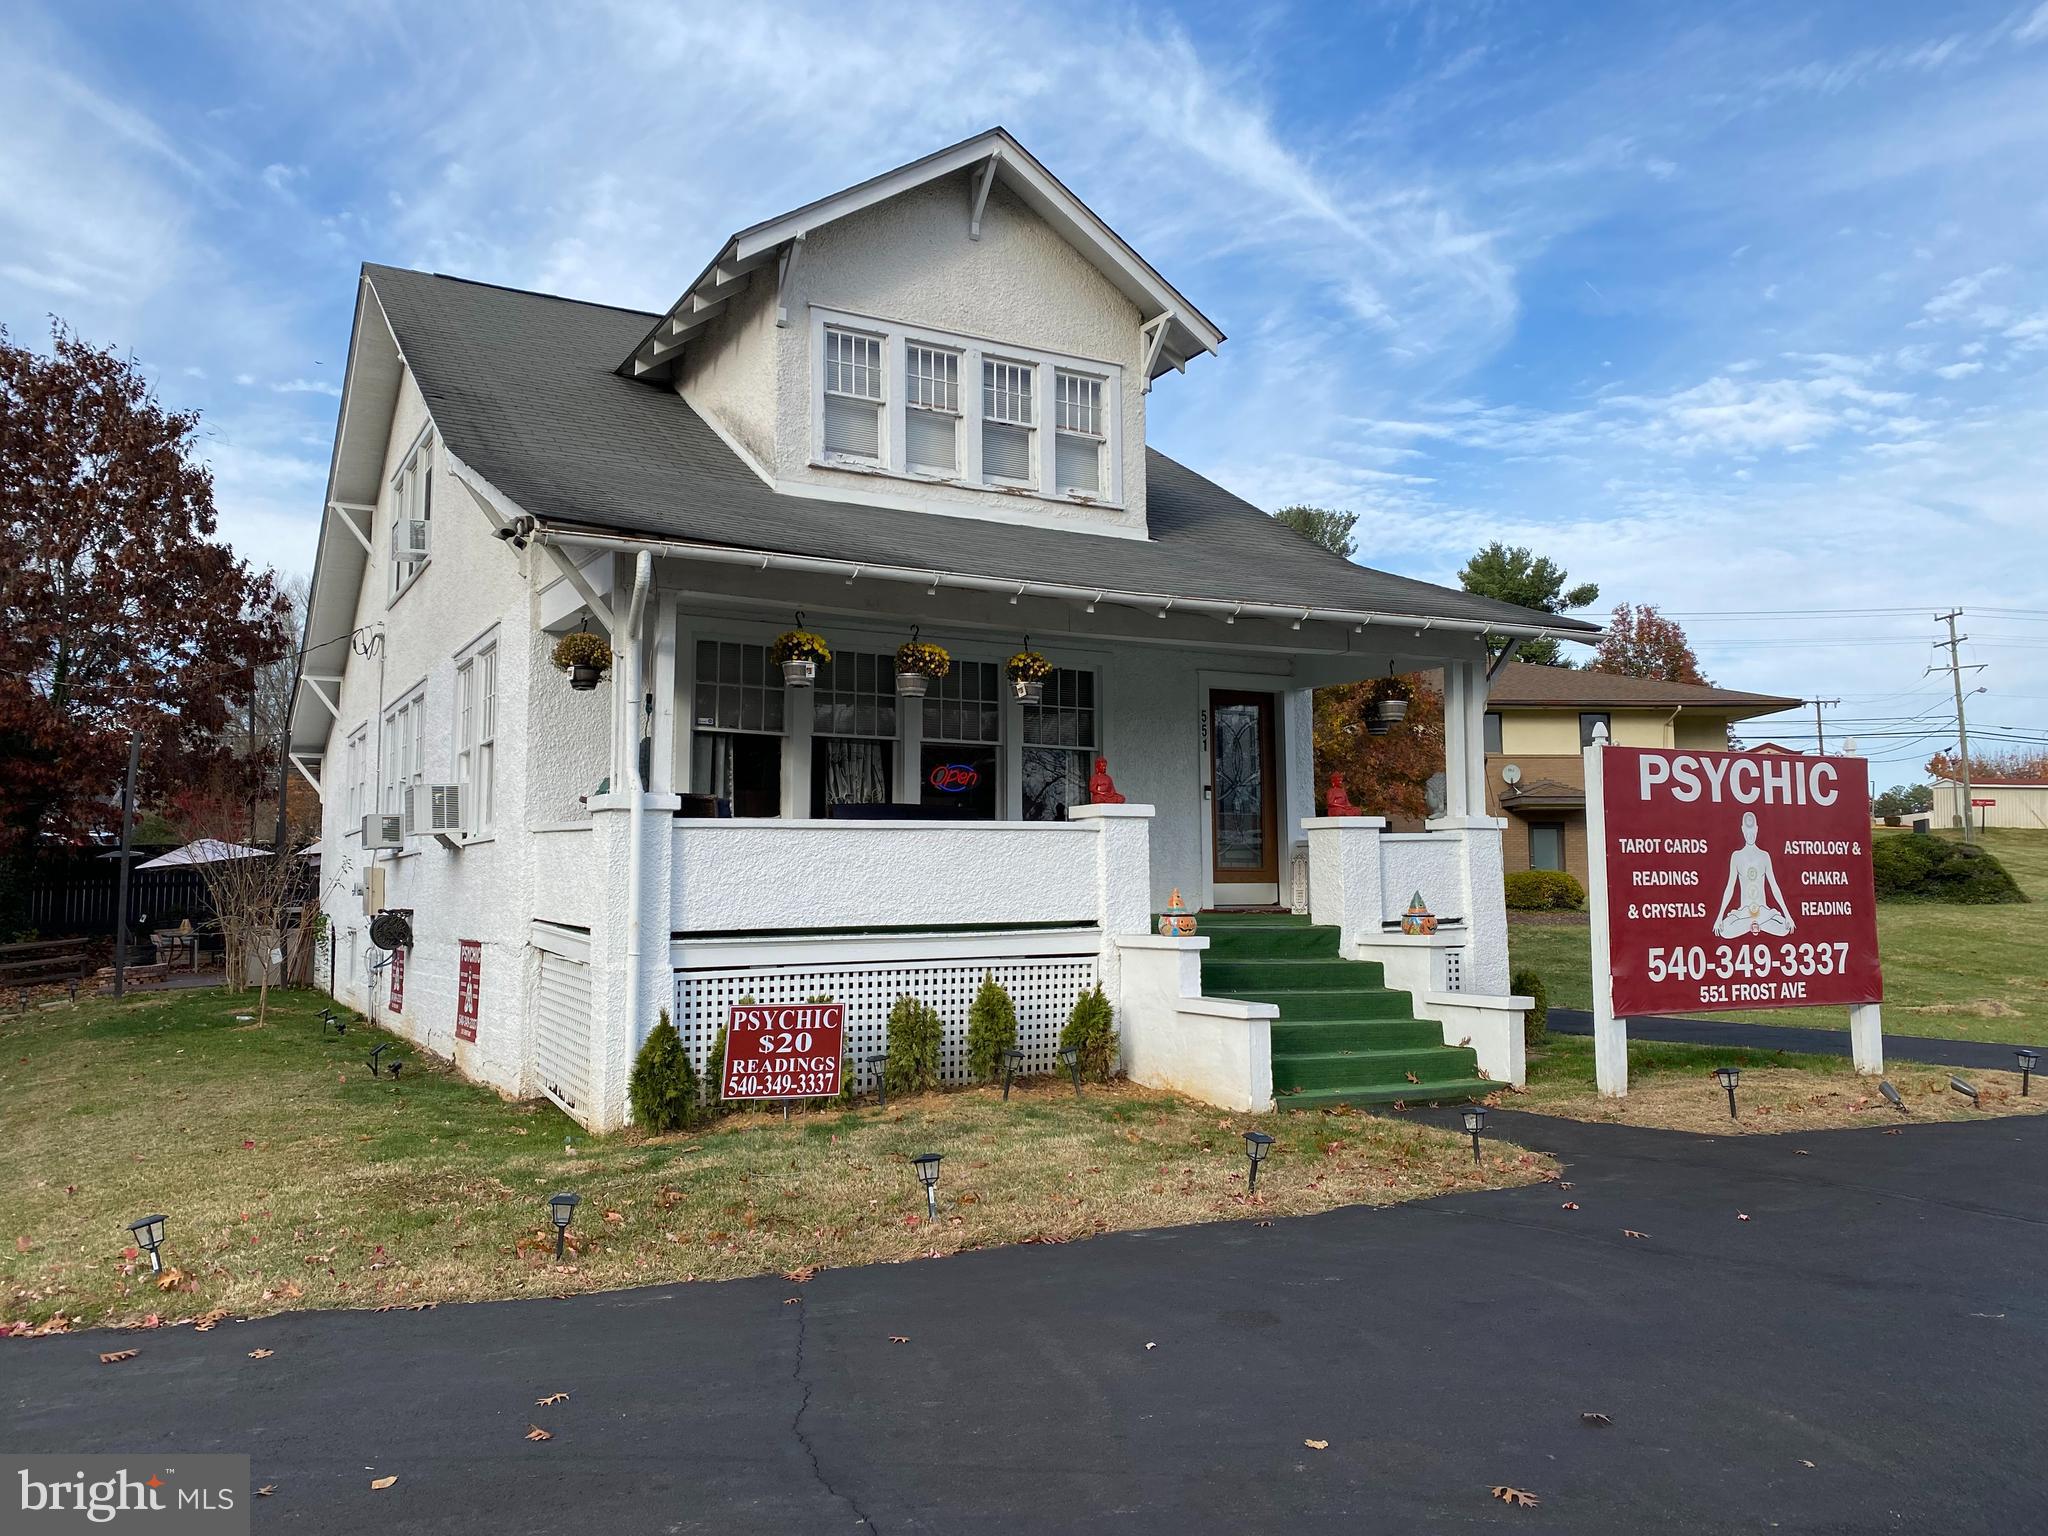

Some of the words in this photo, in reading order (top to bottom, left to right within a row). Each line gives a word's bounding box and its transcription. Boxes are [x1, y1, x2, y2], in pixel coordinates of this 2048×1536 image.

[930, 766, 978, 786] Open
[1639, 754, 1839, 806] PSYCHIC
[1619, 839, 1662, 854] TAROT
[1664, 838, 1708, 854] CARDS
[1784, 841, 1850, 855] ASTROLOGY
[1851, 841, 1861, 855] &
[1632, 870, 1699, 886] READINGS
[1801, 871, 1849, 885] CHAKRA
[1627, 904, 1640, 919] &
[1642, 903, 1706, 919] CRYSTALS
[1801, 901, 1852, 916] READING
[1648, 942, 1849, 982] 540-349-3337
[1700, 986, 1728, 1002] 551
[1731, 982, 1777, 1001] FROST
[1780, 982, 1807, 999] AVE
[732, 1008, 839, 1031] PSYCHIC
[758, 1032, 813, 1054] $20
[732, 1056, 835, 1074] READINGS
[728, 1073, 834, 1096] 540-349-3337
